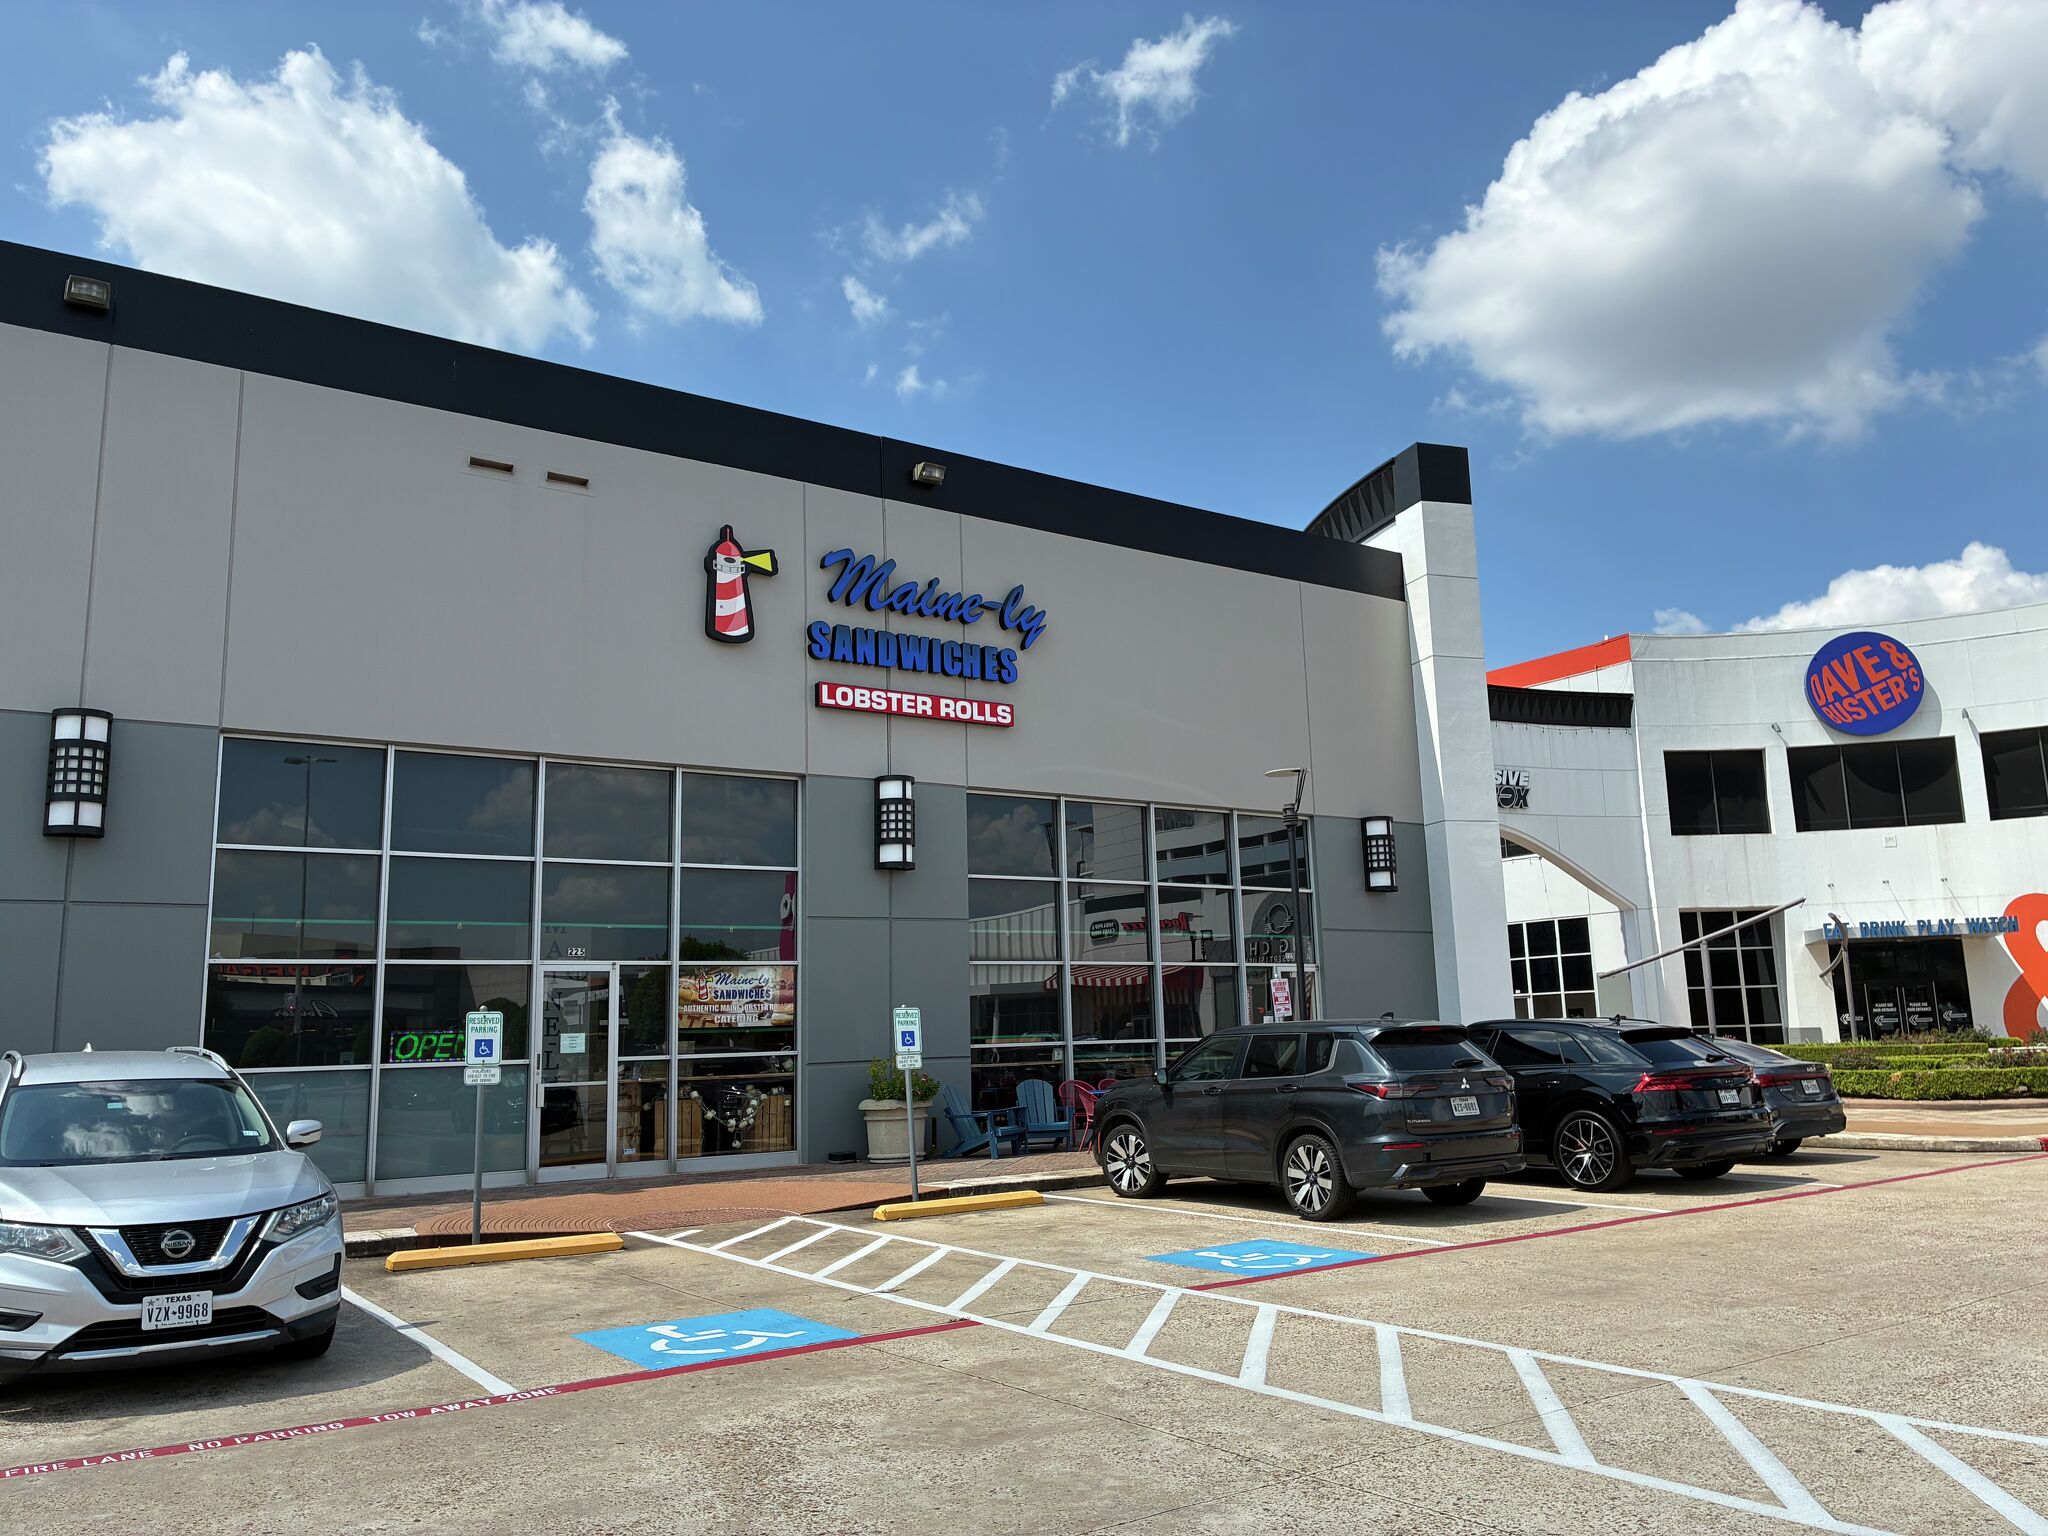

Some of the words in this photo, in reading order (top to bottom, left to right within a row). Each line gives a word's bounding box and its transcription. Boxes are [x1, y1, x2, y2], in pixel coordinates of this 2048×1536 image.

[820, 548, 1047, 650] Maine-ly
[807, 620, 1018, 684] SANDWICHES
[1811, 645, 1891, 706] DAVE
[1880, 641, 1913, 670] &
[1822, 668, 1920, 724] BUSTER'S
[821, 685, 933, 715] LOBSTER
[940, 695, 1012, 724] ROLLS
[1859, 920, 1908, 938] DRINK
[1917, 918, 1955, 936] PLAY
[1965, 916, 2019, 934] WATCH
[569, 947, 585, 956] 225
[714, 971, 770, 986] Maine-ly
[713, 988, 772, 1000] SANDWICHES
[683, 1004, 719, 1013] AUTHENTIC
[720, 1004, 741, 1012] MAINE
[742, 1003, 769, 1011] LOBSTER
[469, 1017, 500, 1025] RESERVED
[714, 1014, 759, 1024] CATERING
[470, 1026, 498, 1034] PARKING
[164, 1240, 193, 1249] NISSAN
[165, 1294, 192, 1304] TEXAS
[4, 1461, 69, 1479] FIRE
[81, 1449, 156, 1467] LANE
[187, 1440, 223, 1453] NO
[233, 1421, 346, 1446] PARKING
[368, 1409, 417, 1424] TOW
[430, 1398, 493, 1415] AWAY
[505, 1387, 563, 1403] ZONE
